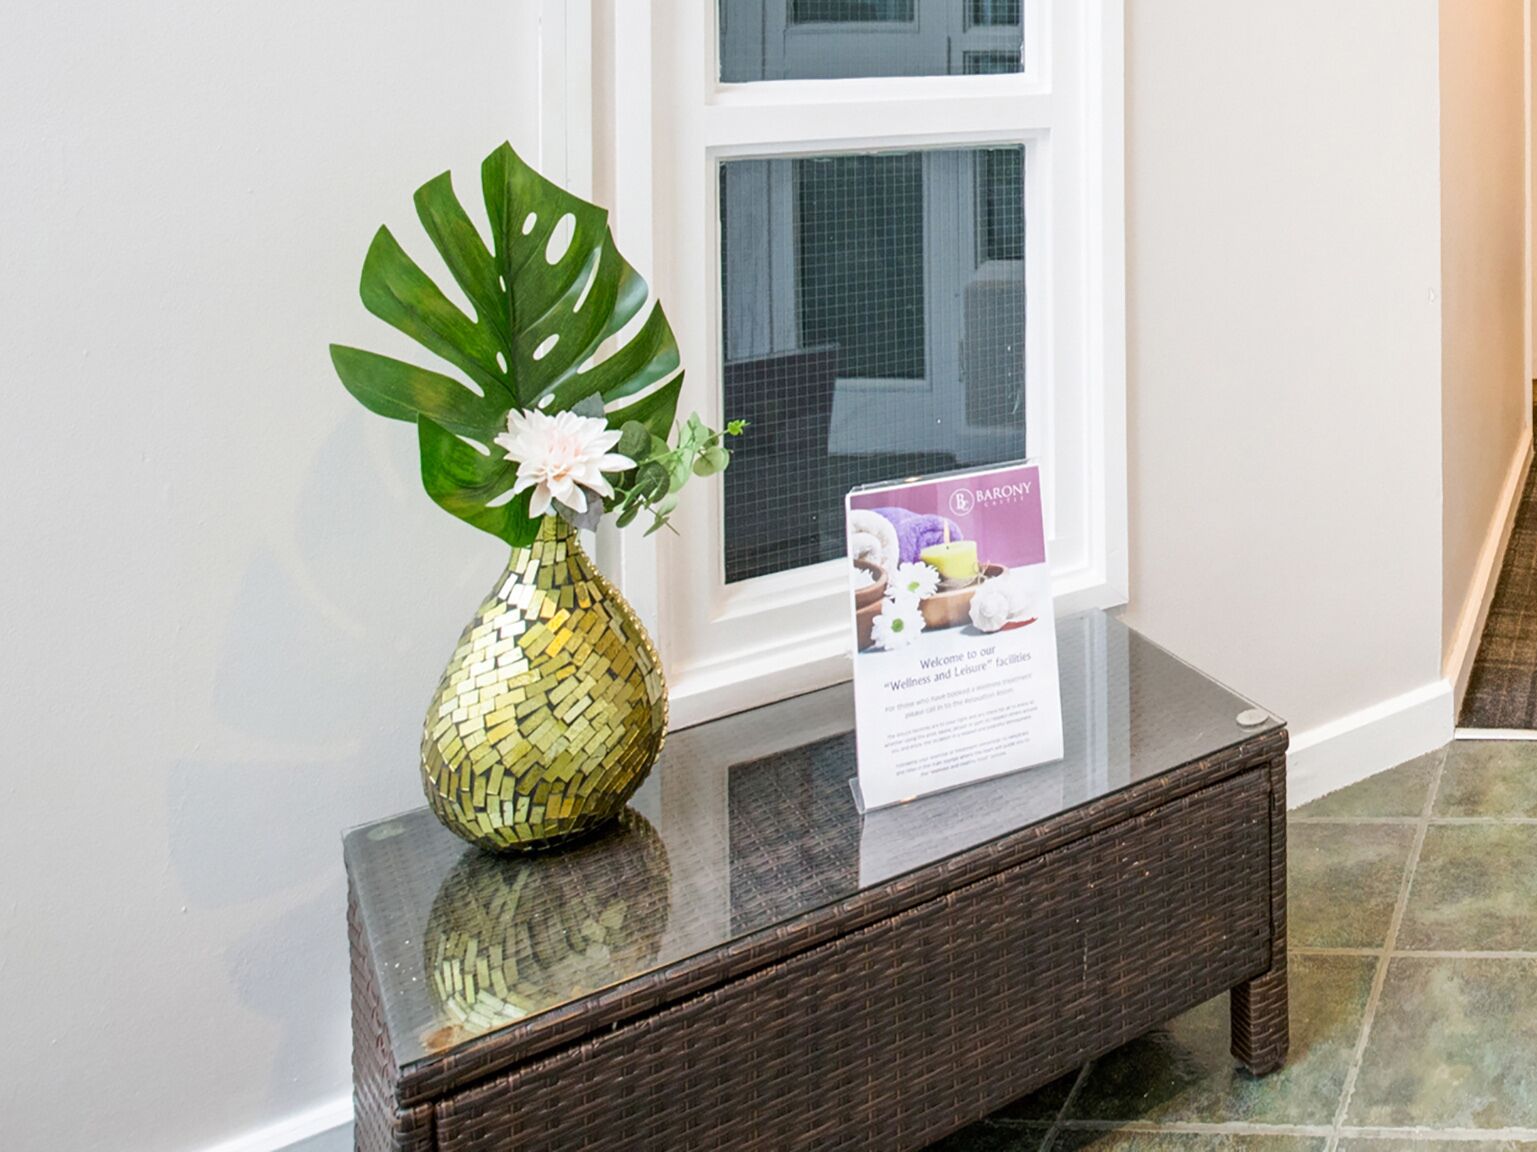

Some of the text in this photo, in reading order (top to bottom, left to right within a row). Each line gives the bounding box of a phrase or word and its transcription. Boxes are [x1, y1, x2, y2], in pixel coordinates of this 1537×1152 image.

[976, 482, 1031, 502] BARONY
[920, 646, 995, 670] Welcome to our
[934, 670, 951, 682] and
[996, 652, 1031, 667] facilities
[897, 702, 914, 710] those
[931, 694, 945, 703] have
[947, 688, 970, 700] booked
